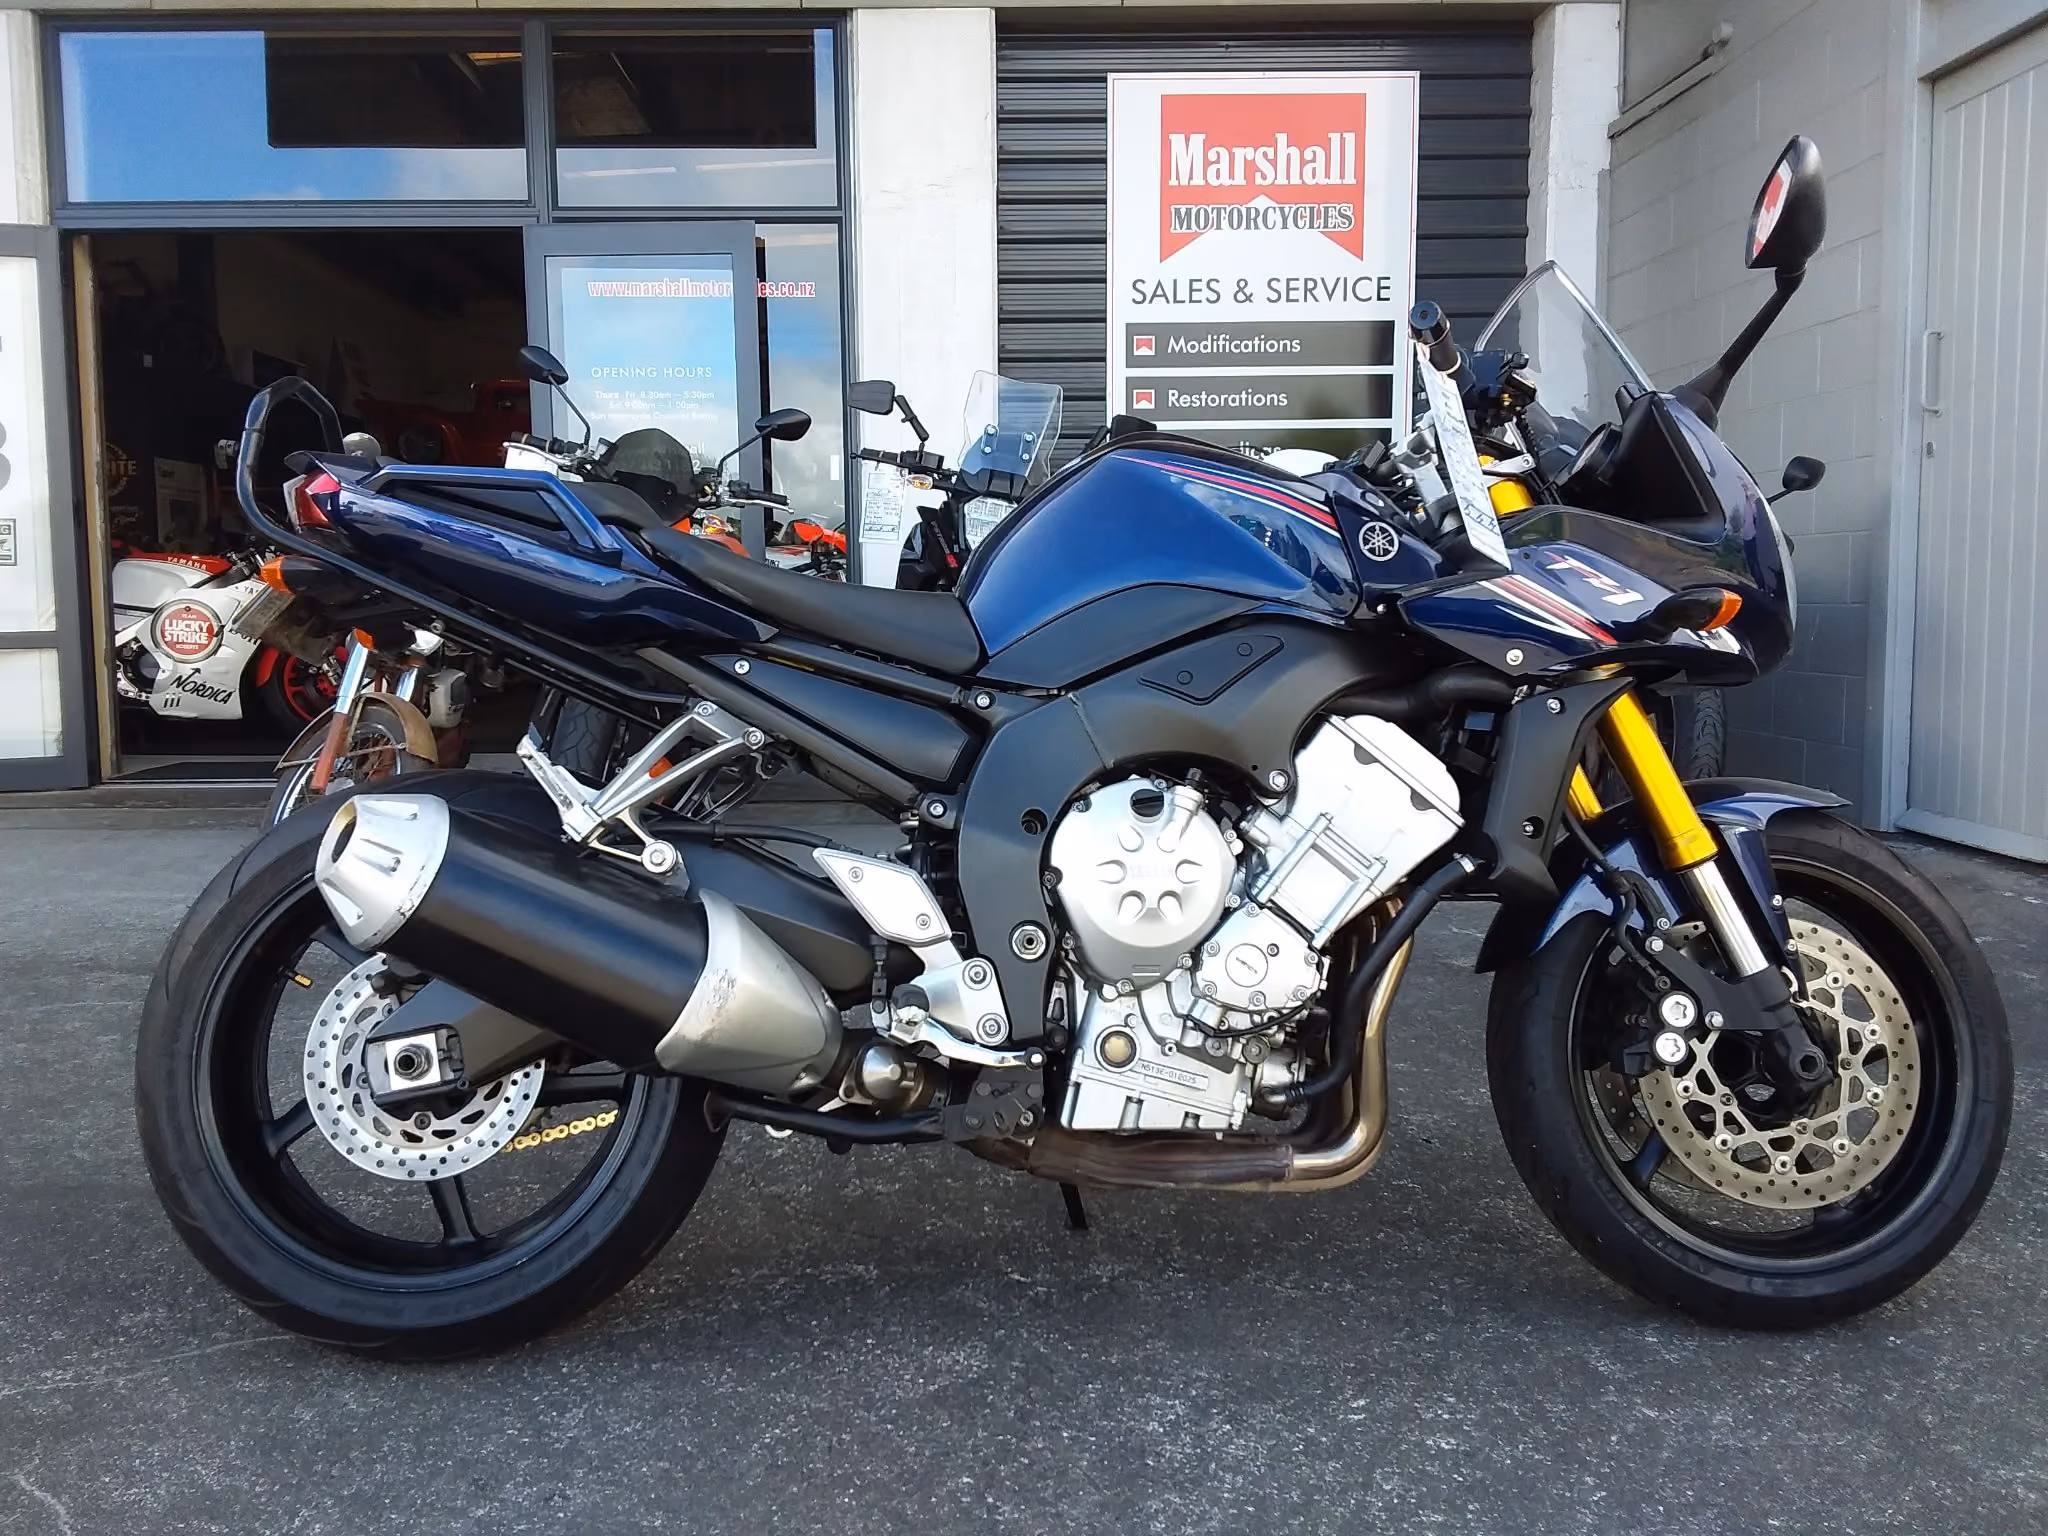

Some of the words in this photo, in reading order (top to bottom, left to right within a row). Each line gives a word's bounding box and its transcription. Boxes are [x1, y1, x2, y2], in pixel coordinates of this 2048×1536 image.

[1168, 132, 1357, 187] Marshall
[1171, 204, 1354, 232] MOTORCYCLES
[588, 278, 815, 298] www.marshallmotorles.co.nz
[1131, 278, 1222, 305] SALES
[1233, 278, 1254, 304] &
[1266, 276, 1392, 304] SERVICE
[1167, 334, 1301, 354] Modifications
[591, 367, 658, 378] OPENING
[664, 367, 713, 378] HOURS
[1167, 388, 1288, 408] Restorations
[167, 556, 207, 571] YAMAHA
[165, 618, 211, 633] LUCKY
[164, 630, 209, 645] STRIKE
[170, 667, 236, 705] NORDICA
